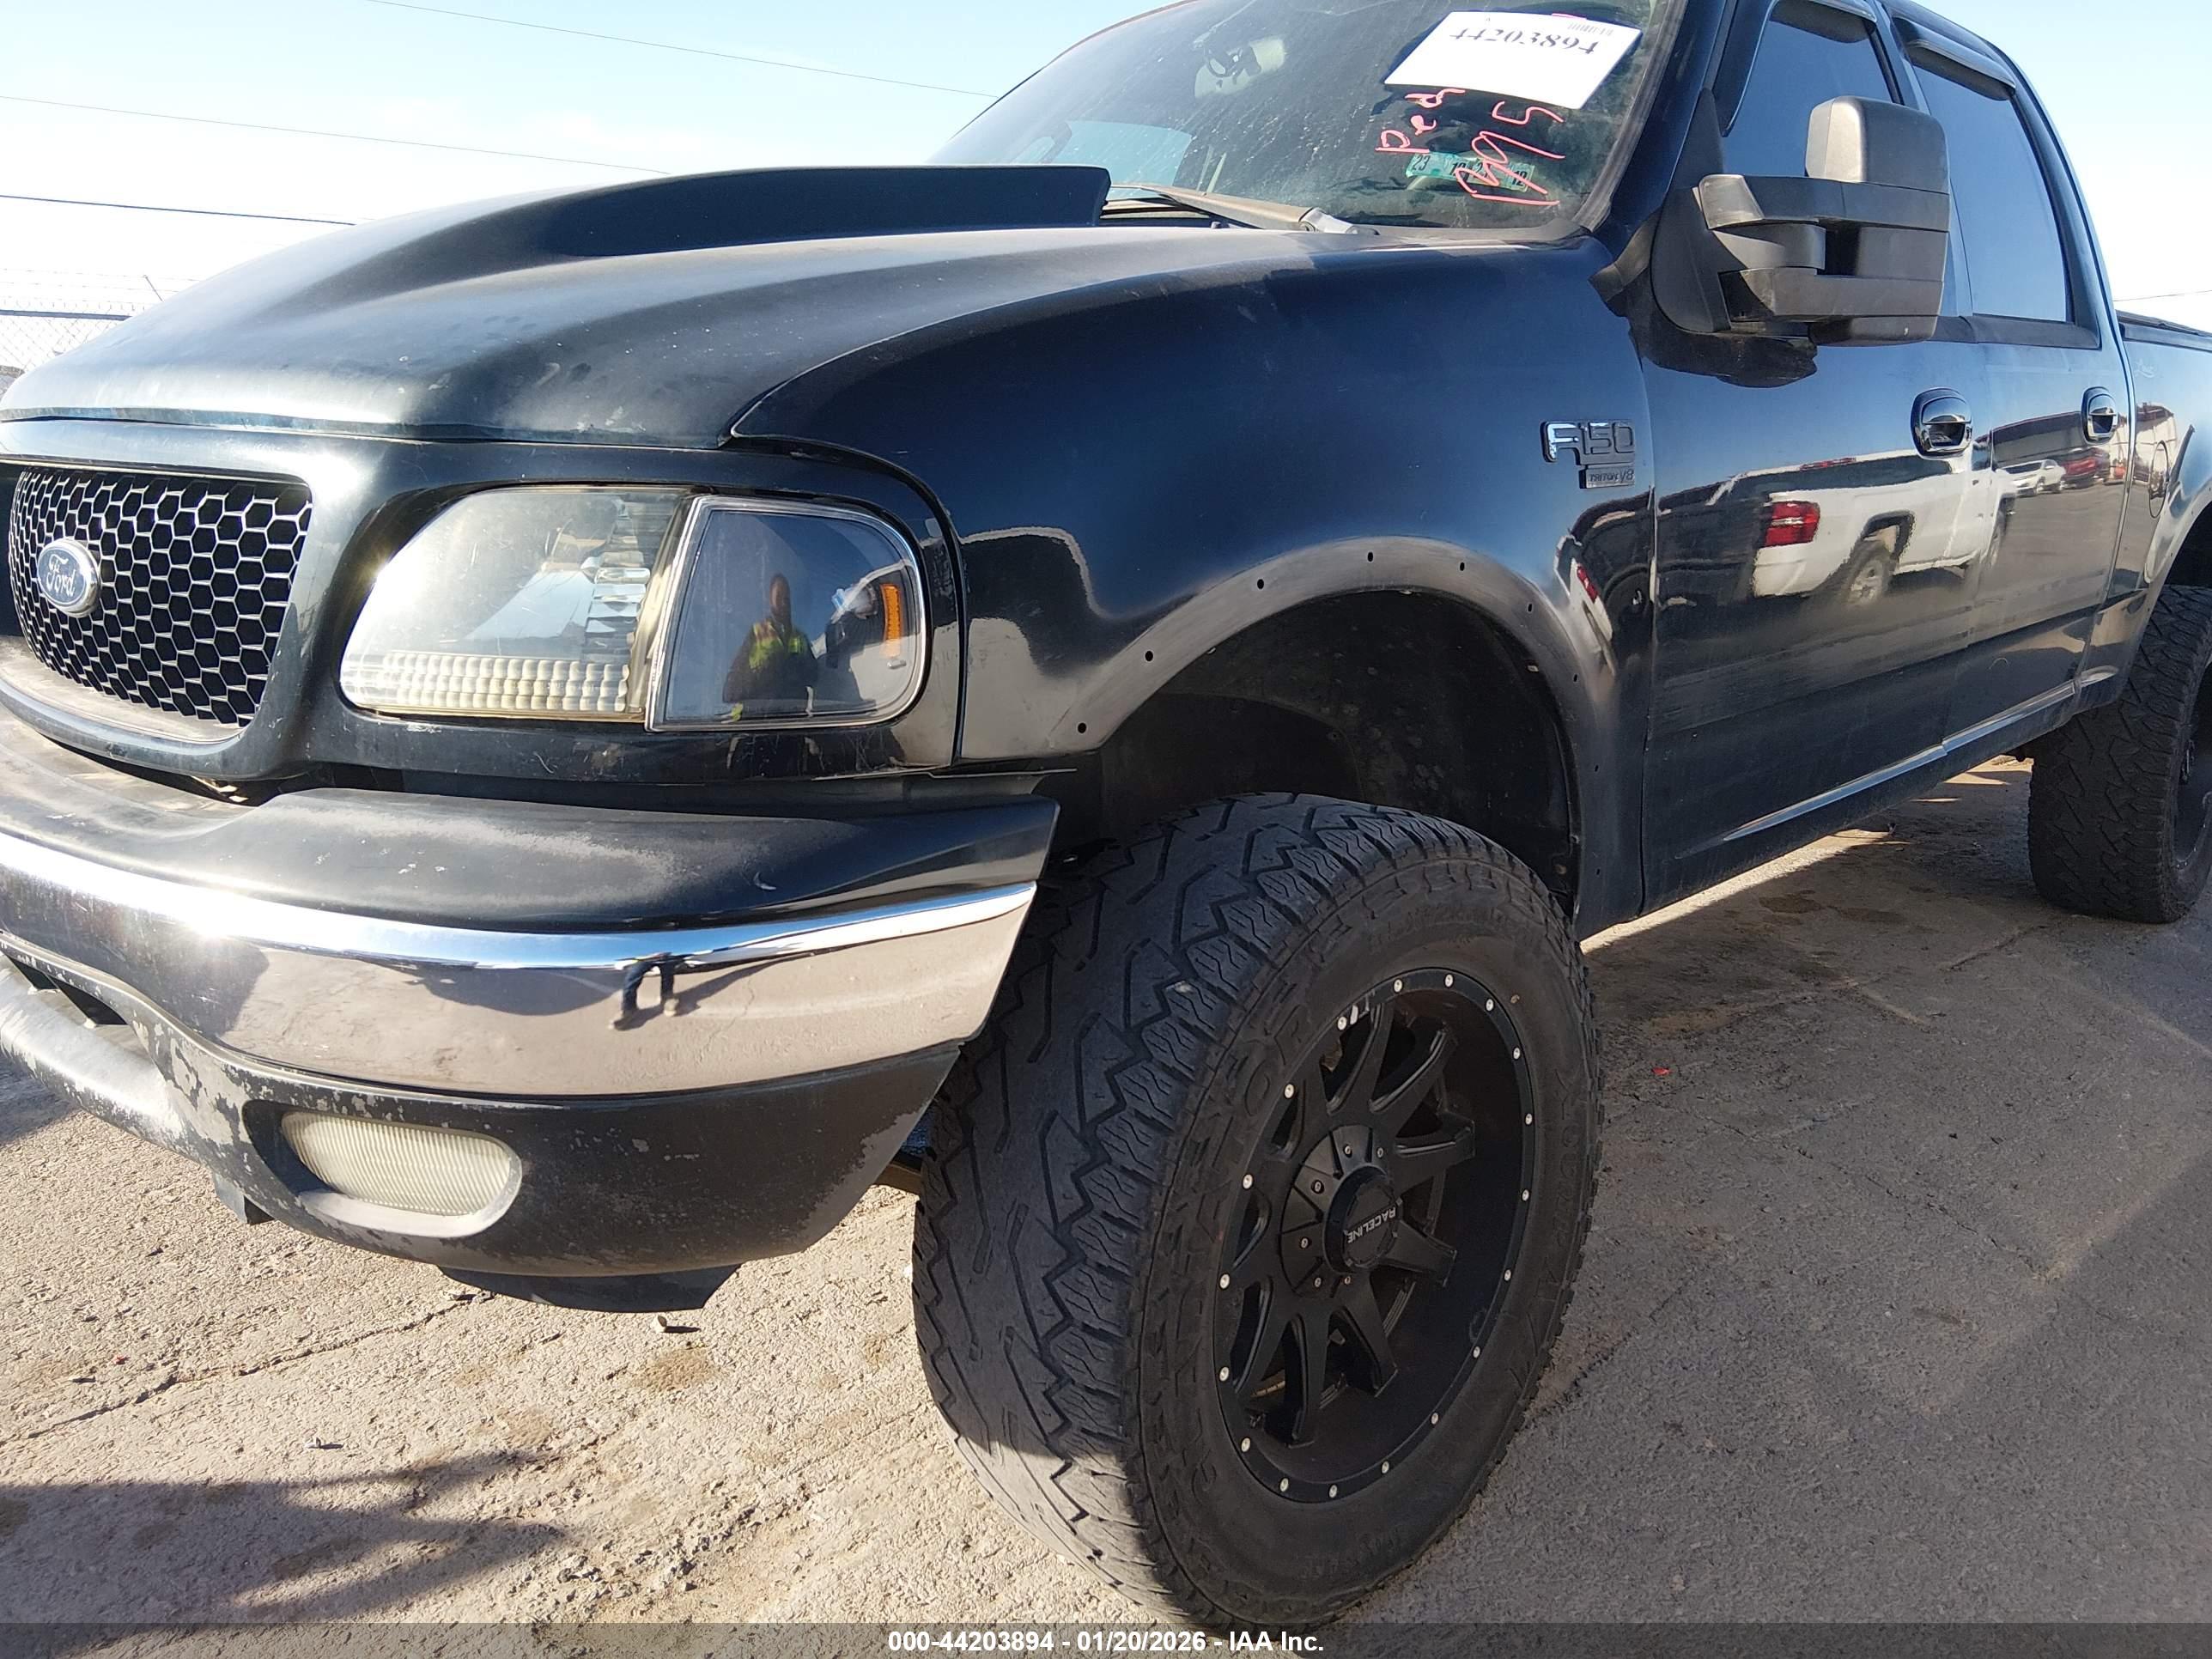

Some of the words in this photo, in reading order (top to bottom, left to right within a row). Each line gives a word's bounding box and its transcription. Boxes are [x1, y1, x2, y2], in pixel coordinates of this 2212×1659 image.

[1620, 470, 1634, 482] V8
[46, 553, 76, 597] Ford
[1347, 1206, 1396, 1243] RACELINE
